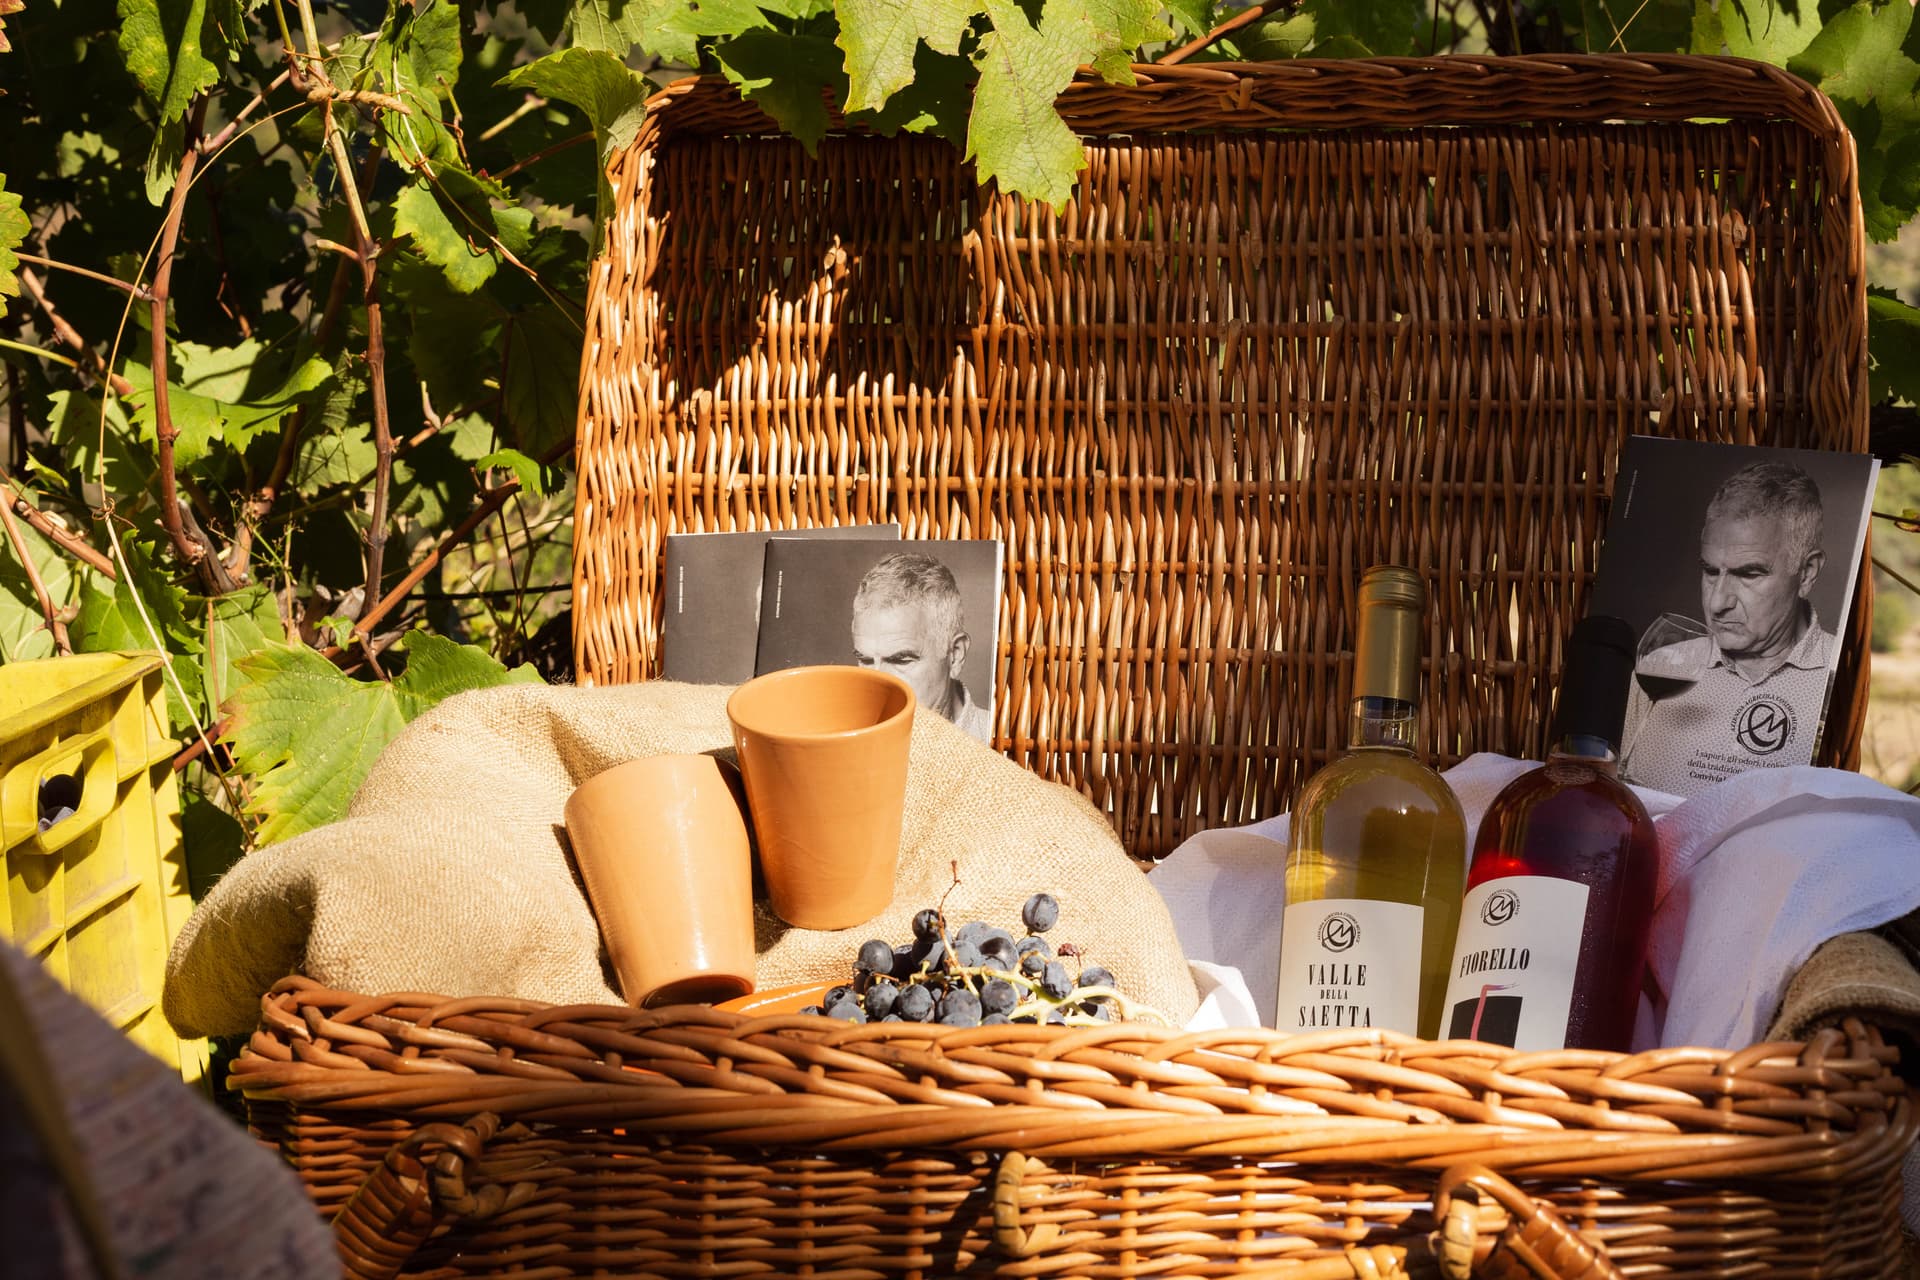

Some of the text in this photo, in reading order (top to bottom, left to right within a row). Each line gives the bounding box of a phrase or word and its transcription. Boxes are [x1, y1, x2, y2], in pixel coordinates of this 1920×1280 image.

[1687, 759, 1706, 769] della
[1459, 947, 1532, 979] FIORELLO
[1308, 964, 1367, 987] VALLE
[1319, 989, 1349, 1000] DELLA
[1298, 1004, 1371, 1029] SAETTA
